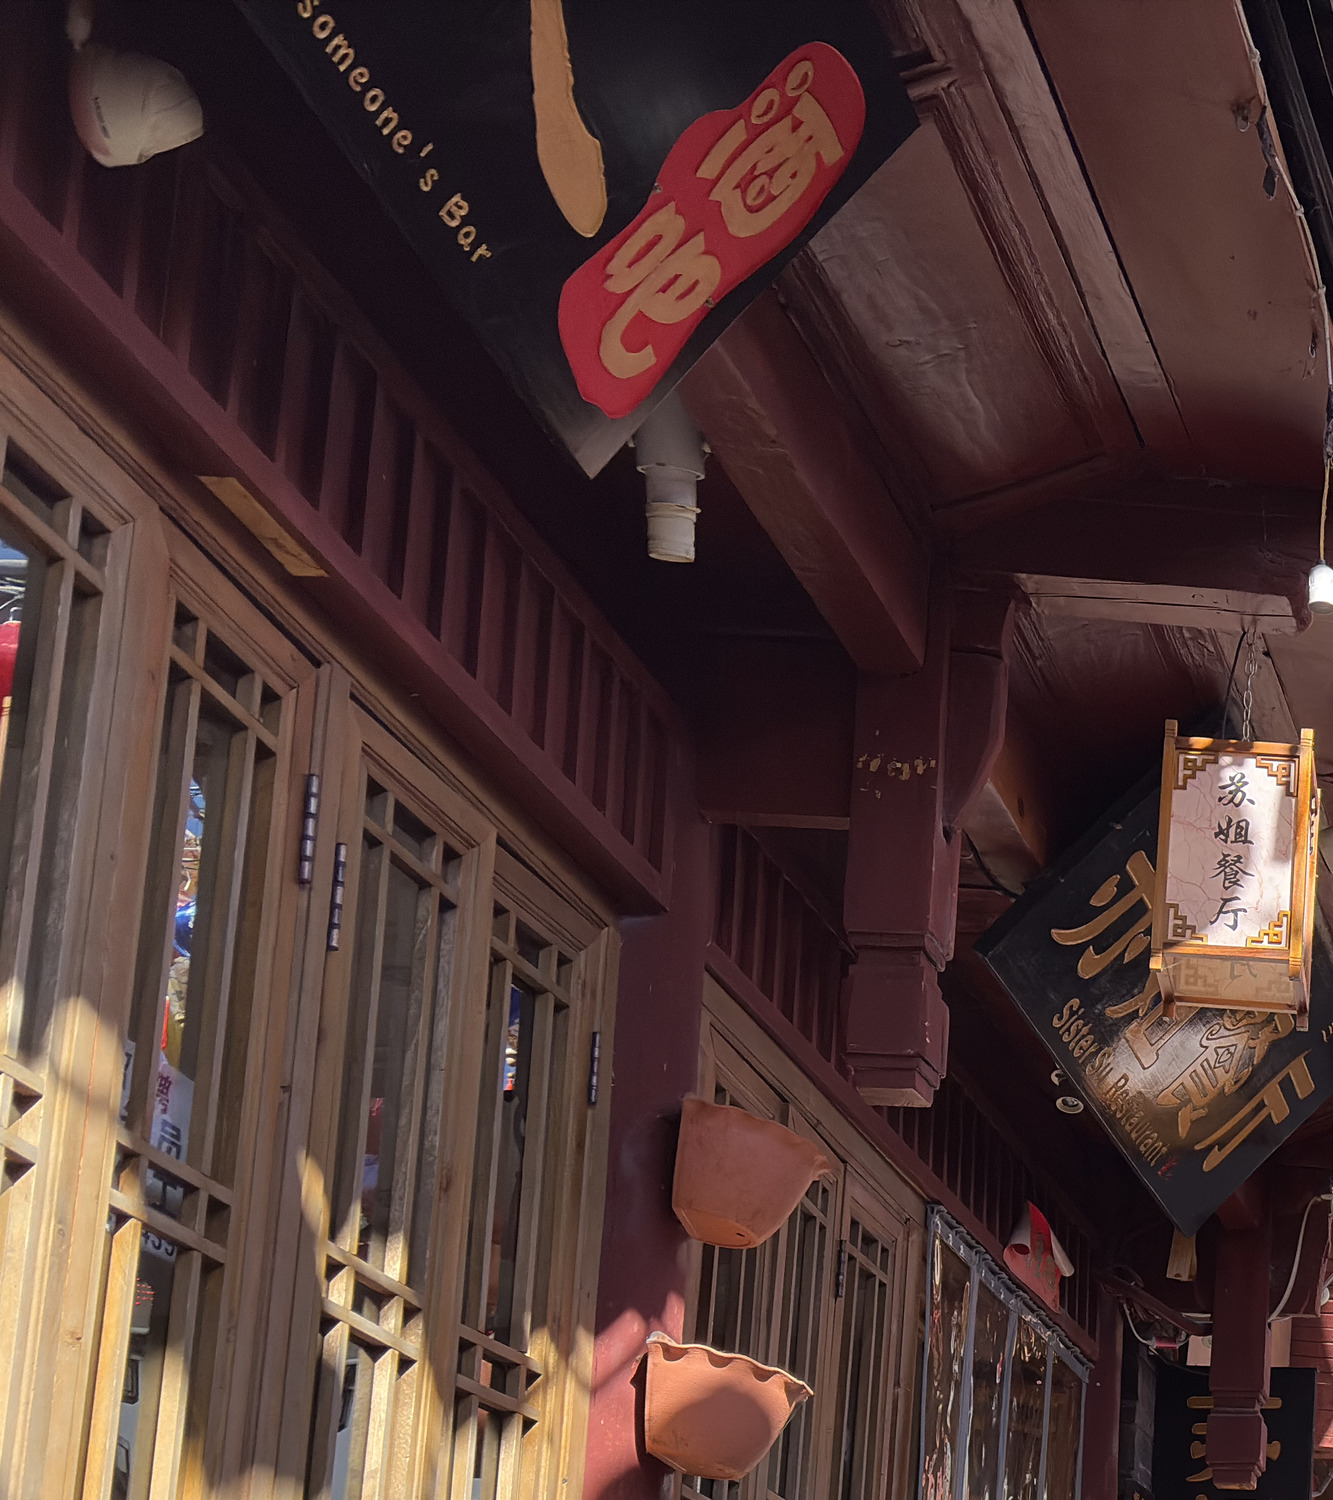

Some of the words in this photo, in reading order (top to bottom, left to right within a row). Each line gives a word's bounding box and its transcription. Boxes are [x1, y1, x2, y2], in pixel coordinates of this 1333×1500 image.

[438, 192, 493, 263] Bar
[599, 60, 845, 379] 酒吧
[1209, 772, 1256, 932] 苏姐餐厅
[1052, 998, 1099, 1065] Sister
[1085, 1047, 1113, 1086] Su
[1102, 1074, 1168, 1167] Restaurant
